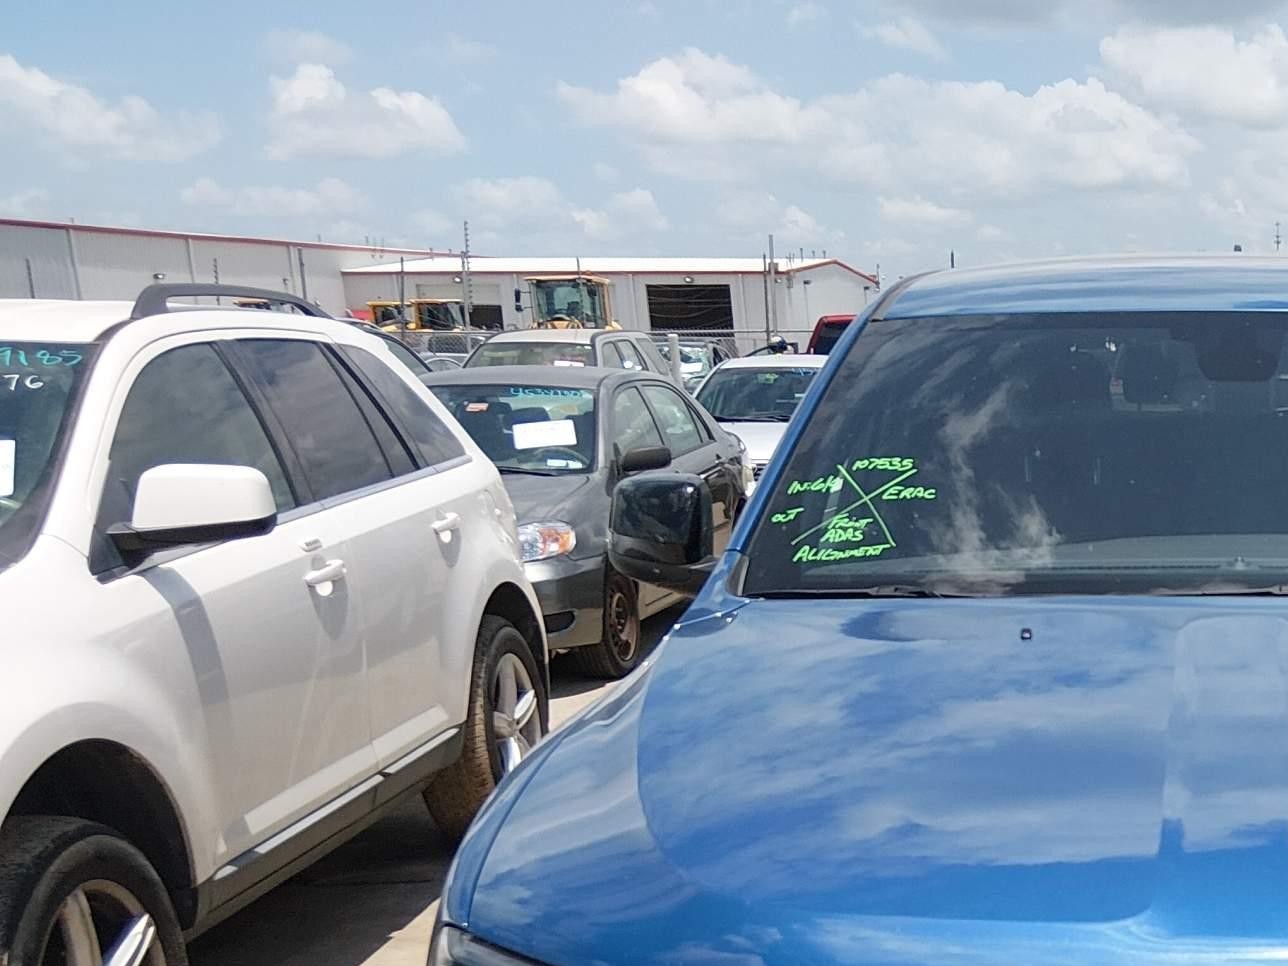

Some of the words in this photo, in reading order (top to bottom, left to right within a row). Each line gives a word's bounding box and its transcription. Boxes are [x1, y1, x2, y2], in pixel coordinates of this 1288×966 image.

[852, 457, 913, 472] 107535
[882, 486, 936, 500] ERAC
[820, 529, 864, 543] ADAS
[792, 544, 892, 562] ALIGNMENT
